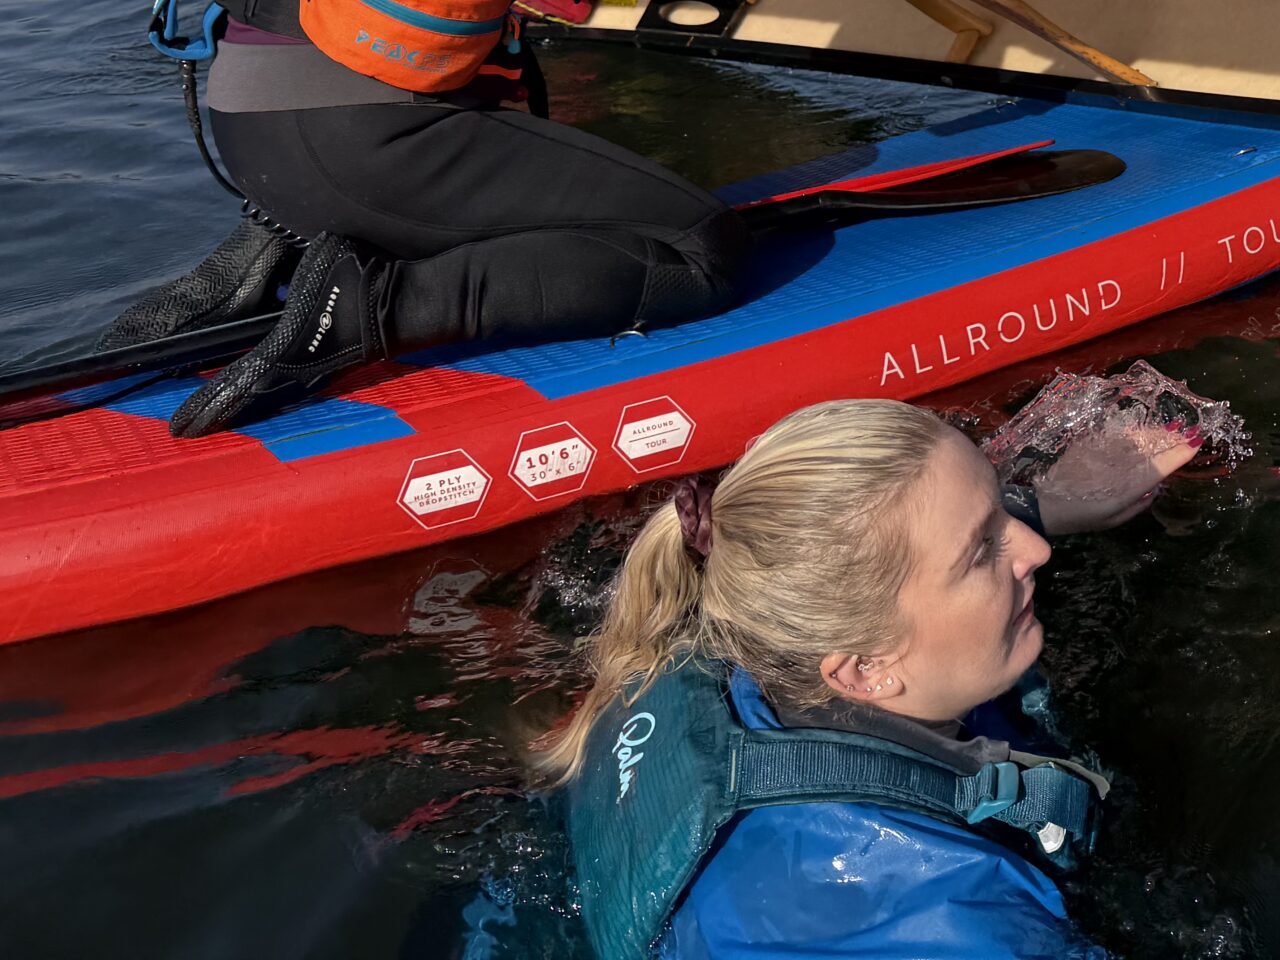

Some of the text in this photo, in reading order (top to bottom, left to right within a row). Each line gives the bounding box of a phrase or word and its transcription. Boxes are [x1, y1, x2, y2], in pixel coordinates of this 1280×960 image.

[308, 286, 340, 353] AQUA LUNG
[879, 279, 1123, 386] ALLROUND
[632, 420, 674, 435] ALLROUND
[645, 438, 667, 449] TOUR
[414, 481, 477, 501] HIGH DENSITY
[425, 475, 462, 491] 2 PLY
[418, 489, 475, 507] DROPSTITCH
[611, 712, 656, 799] Palm
